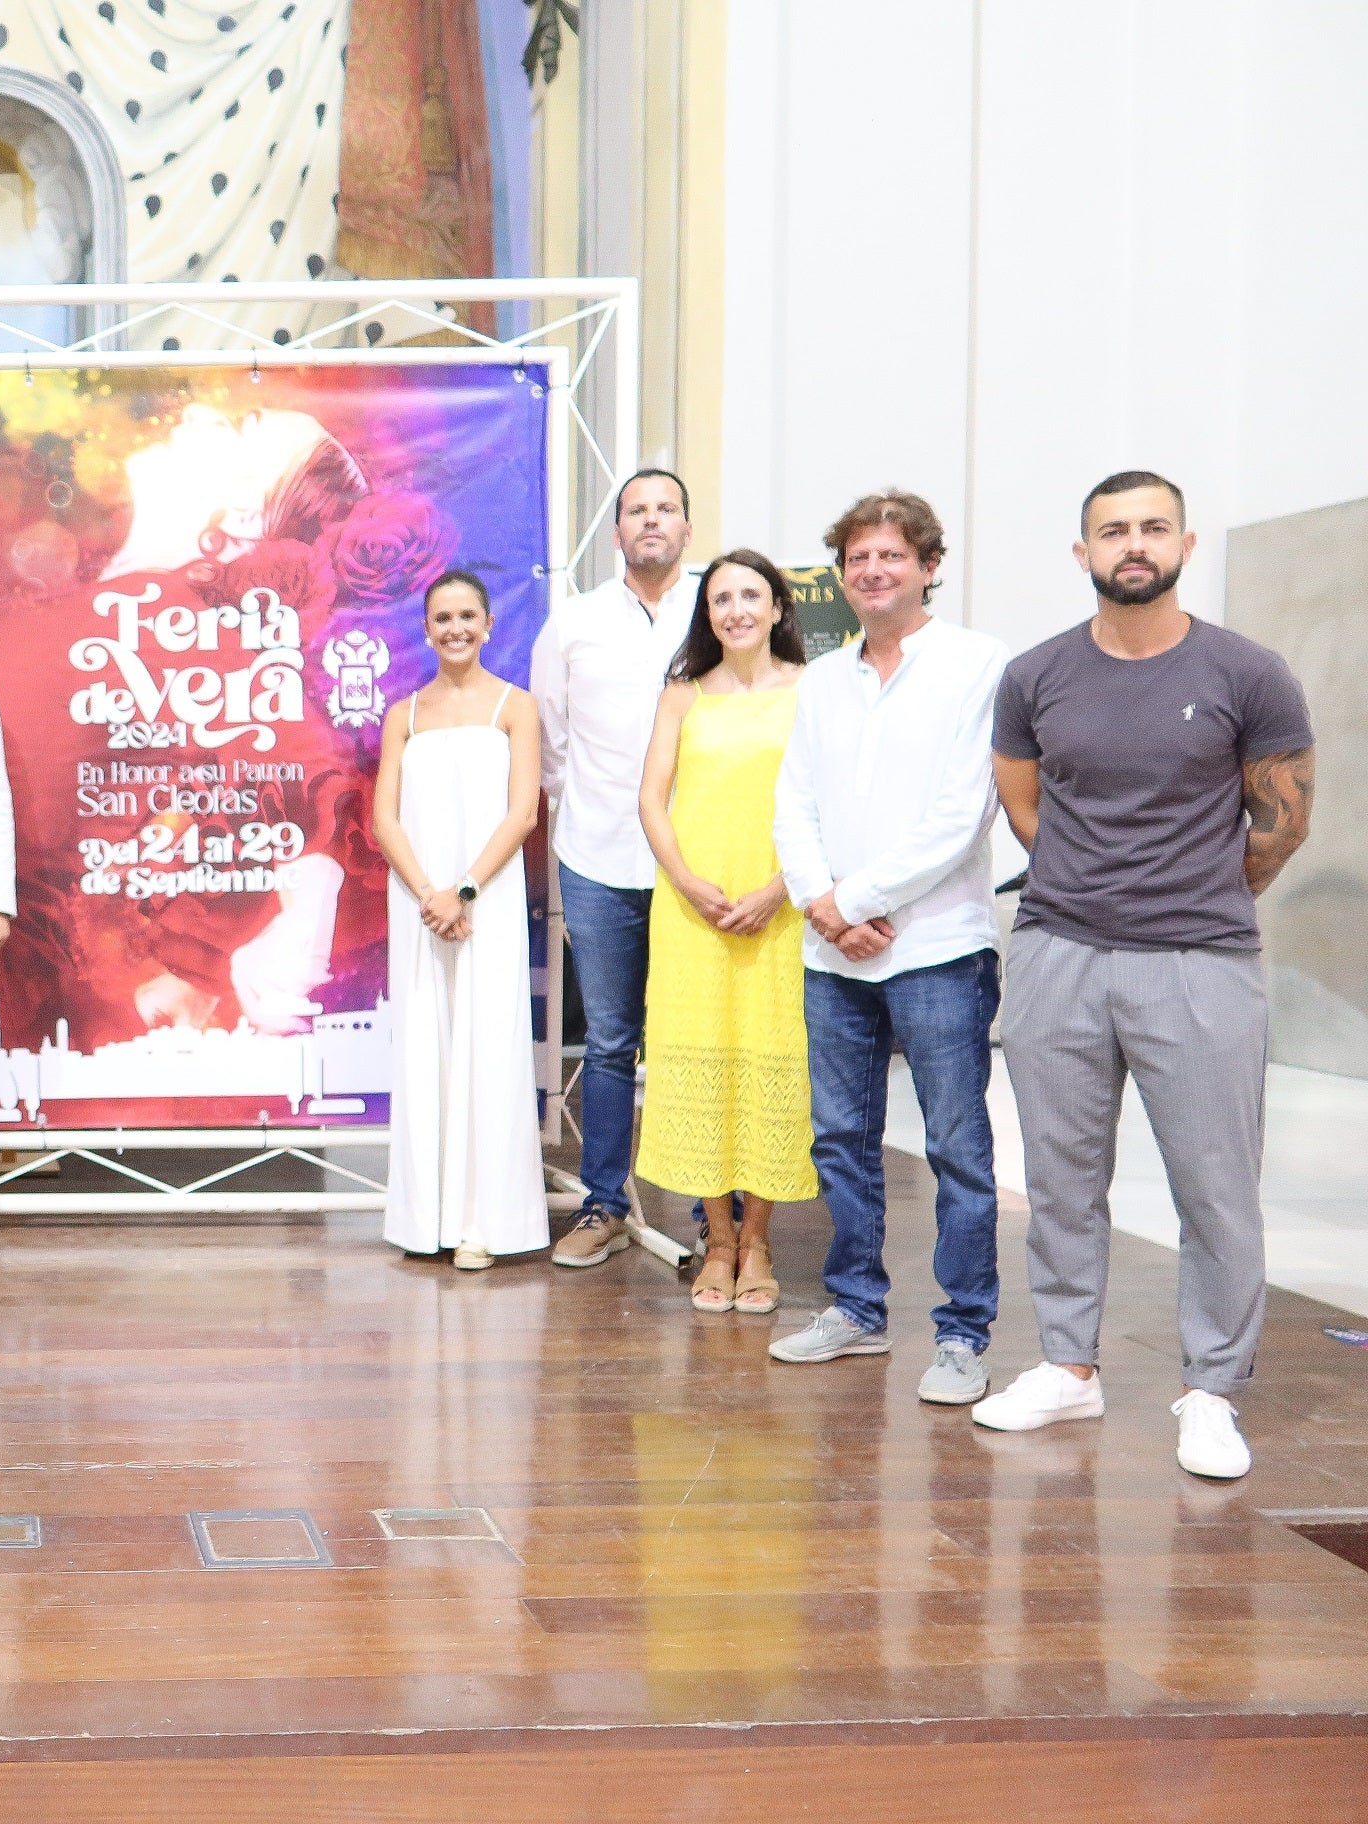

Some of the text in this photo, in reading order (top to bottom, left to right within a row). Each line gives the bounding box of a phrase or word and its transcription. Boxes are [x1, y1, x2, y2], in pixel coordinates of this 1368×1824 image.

[92, 582, 301, 652] Feria
[68, 636, 304, 752] de Vera
[107, 720, 187, 750] 2024
[77, 761, 105, 785] En
[111, 760, 172, 785] Honor
[179, 764, 194, 783] a
[199, 763, 226, 783] su
[77, 785, 138, 817] San
[78, 821, 305, 870] Del 24 al 29
[80, 863, 302, 900] de Septiembre
